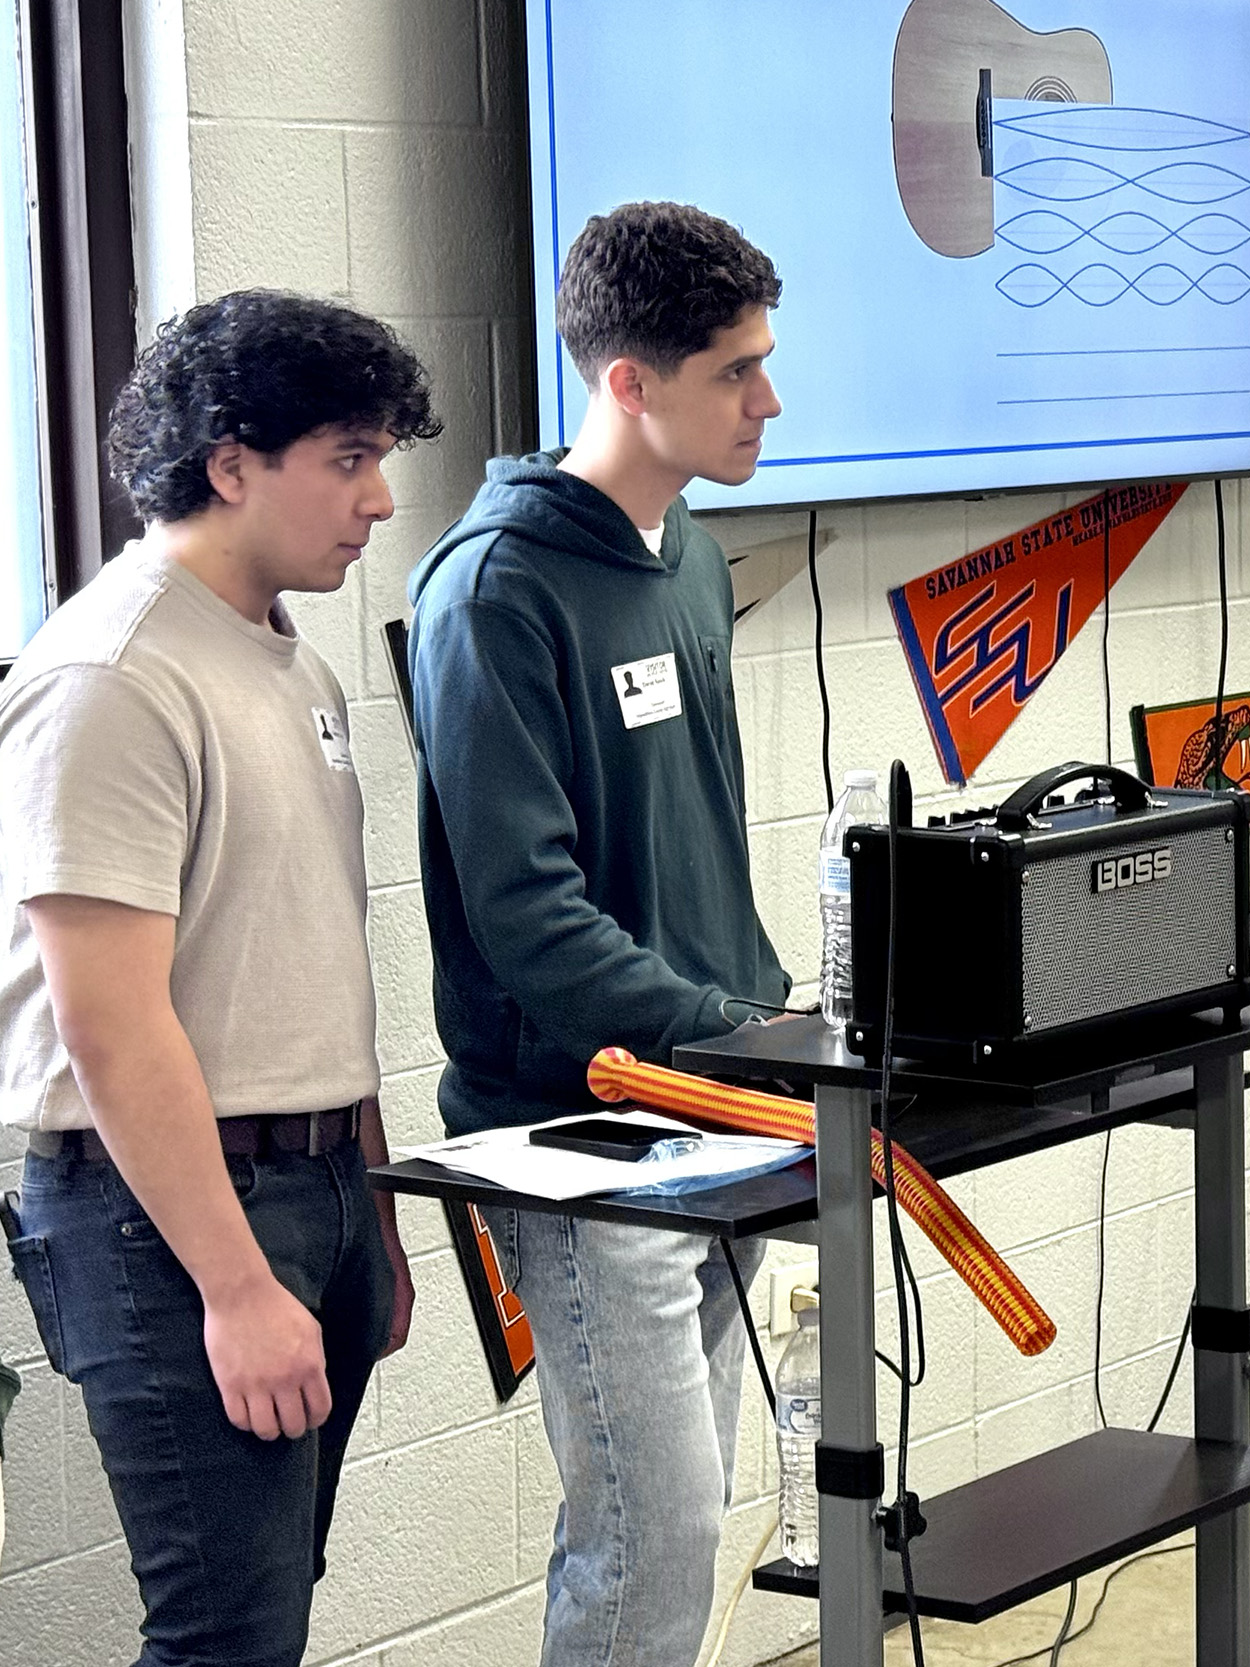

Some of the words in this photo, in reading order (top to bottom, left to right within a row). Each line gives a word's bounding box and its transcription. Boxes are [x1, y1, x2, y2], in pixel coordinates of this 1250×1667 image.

[925, 541, 1016, 599] SAVANNAH
[1021, 514, 1074, 556] STATE
[1098, 850, 1172, 892] BOSS
